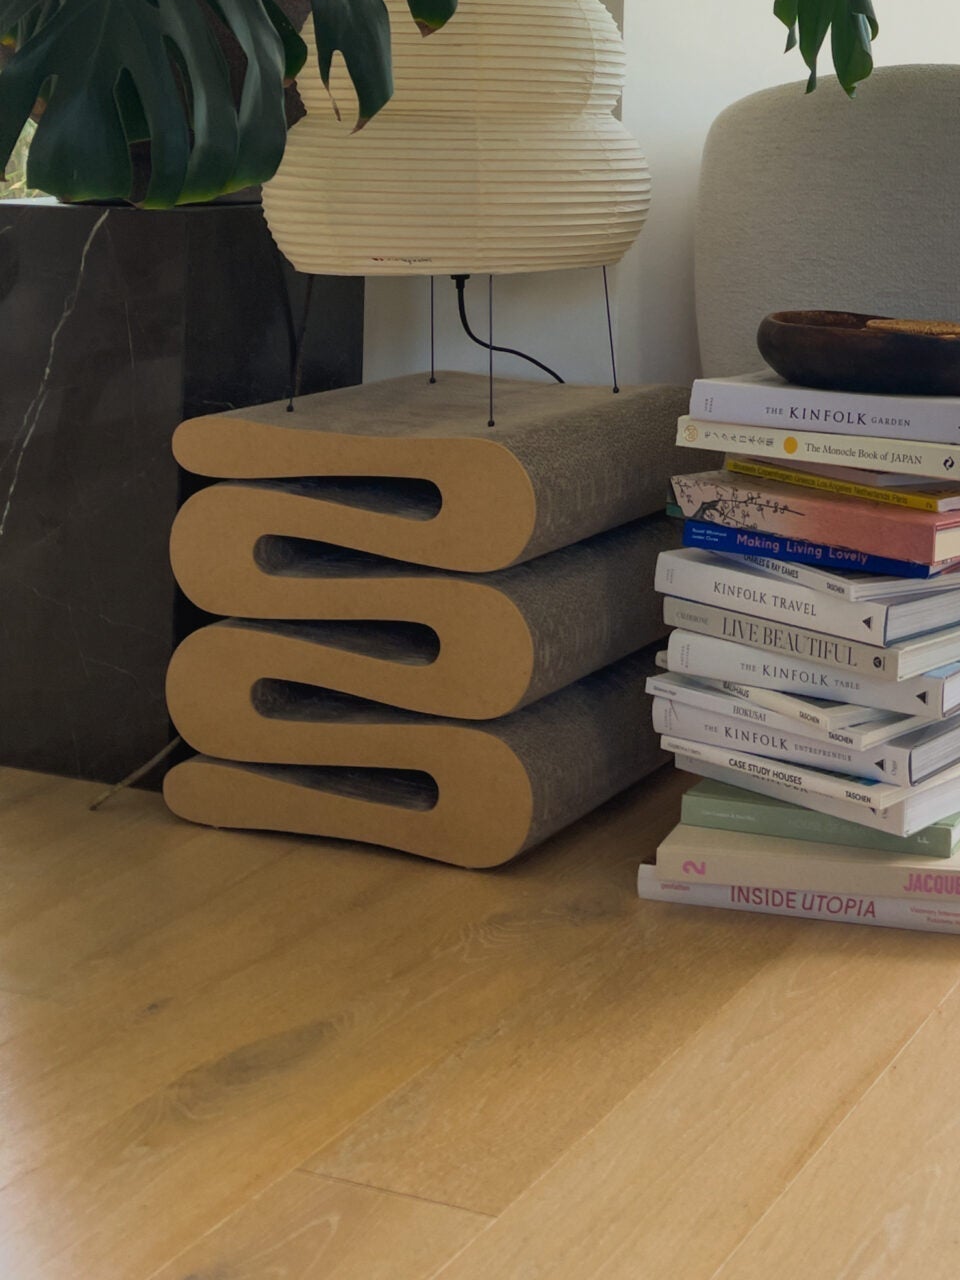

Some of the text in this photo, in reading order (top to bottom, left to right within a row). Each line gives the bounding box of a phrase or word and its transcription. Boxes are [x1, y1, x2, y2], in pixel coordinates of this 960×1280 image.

[765, 406, 911, 427] THE KINFOLK GARDEN
[805, 442, 922, 465] The Monocle Book of JAPAN
[736, 533, 869, 565] Making Living Lovely
[771, 560, 781, 573] RAY
[781, 565, 799, 579] EAMES
[713, 581, 817, 617] KINFOLK TRAVEL
[722, 617, 759, 643] LIVE
[762, 625, 858, 667] BEAUTIFUL
[740, 663, 861, 690] THE KINFOLK TABLE
[722, 680, 750, 699] BAUHAUS
[732, 705, 767, 722] HOKUSAI
[799, 710, 820, 725] TASCHEN
[703, 724, 718, 733] THE
[724, 726, 788, 751] KINFOLK
[794, 743, 853, 762] ENTREPRENEUR
[828, 731, 854, 745] TASCHEN
[728, 758, 746, 770] CASE
[747, 763, 771, 777] STUDY
[772, 770, 803, 786] HOUSES
[845, 790, 872, 804] TASCHEN
[682, 859, 707, 876] 2
[730, 885, 877, 919] INSIDE UTOPIA
